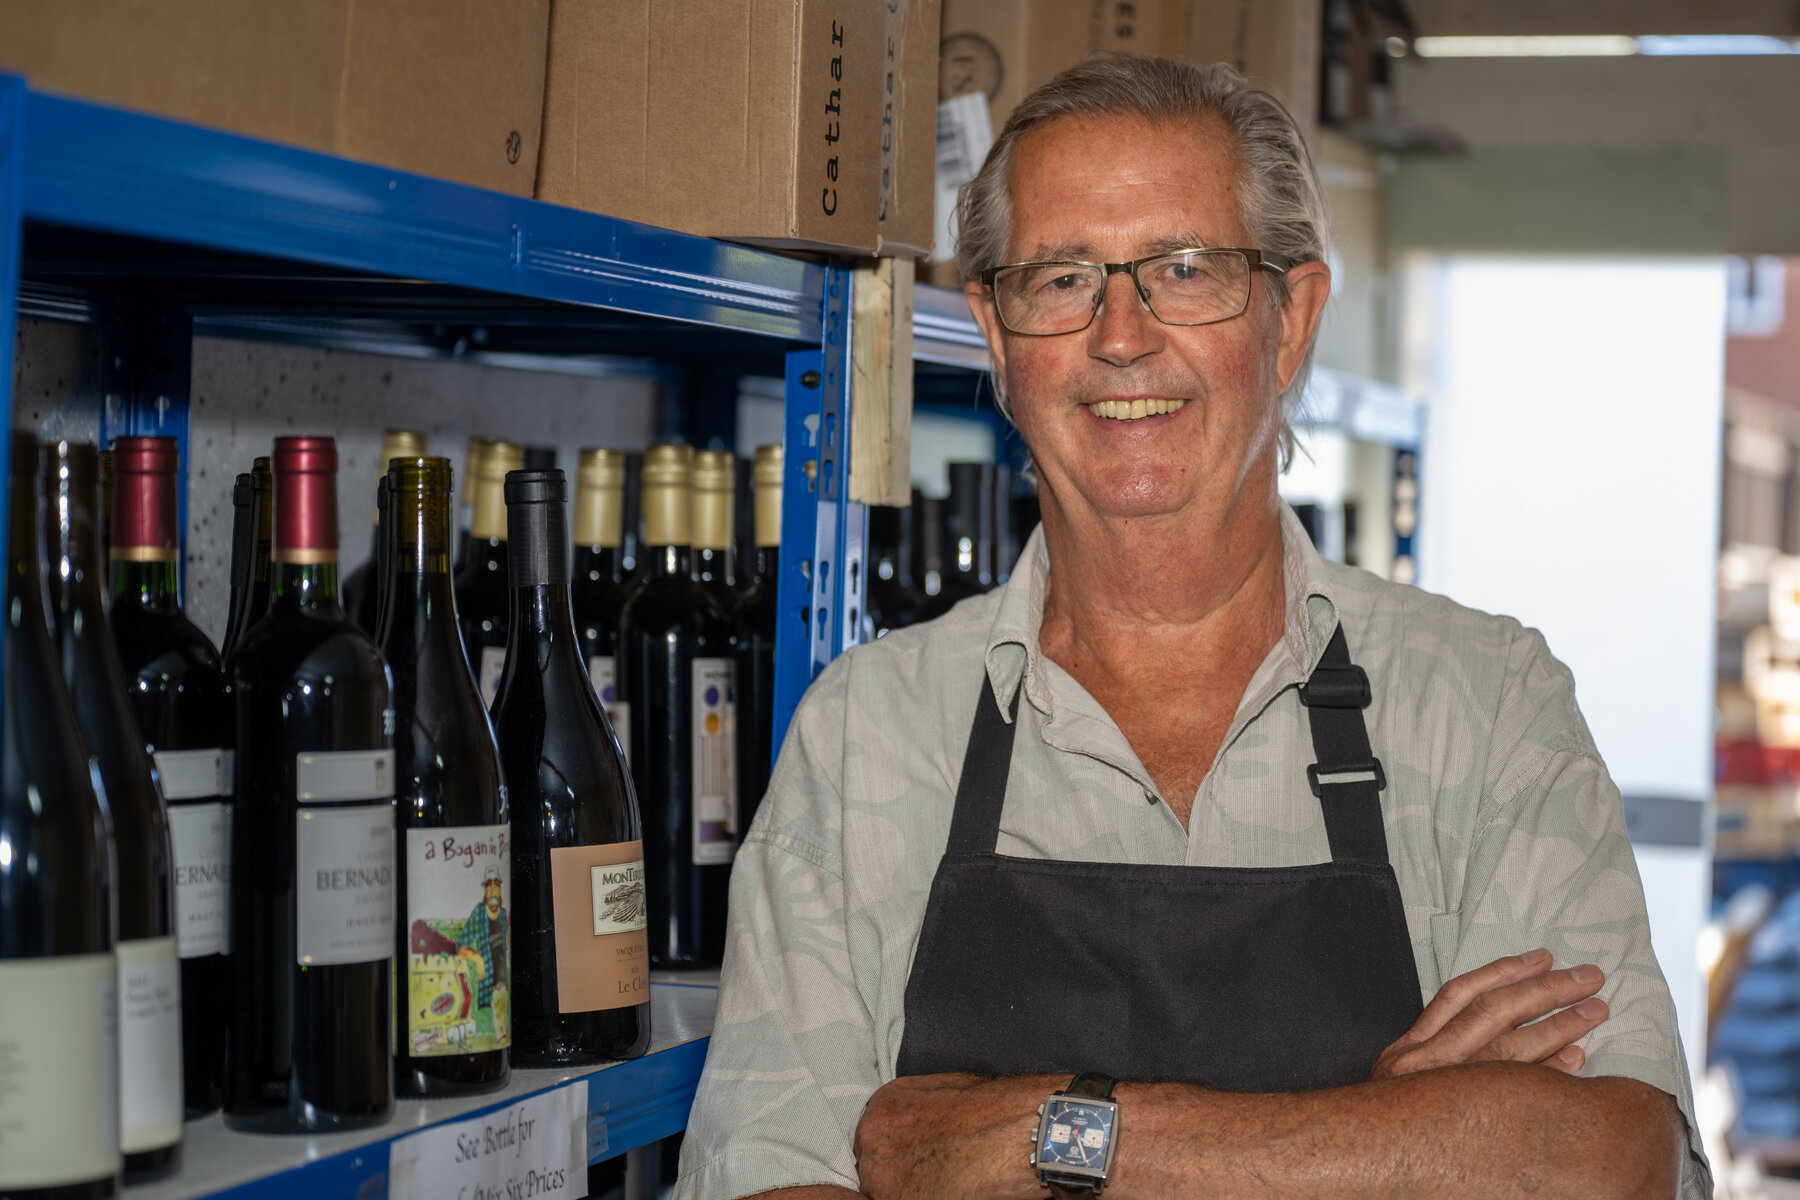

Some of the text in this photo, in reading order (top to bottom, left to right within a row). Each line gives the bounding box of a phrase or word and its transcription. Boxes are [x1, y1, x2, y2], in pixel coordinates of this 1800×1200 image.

[822, 19, 844, 217] Cathar
[878, 36, 895, 222] Cathar
[424, 841, 436, 860] a
[442, 836, 487, 868] Bogan
[489, 837, 497, 856] in
[316, 865, 393, 891] BERNAD
[618, 980, 630, 994] Le
[455, 1106, 535, 1163] See Bottle for
[525, 1166, 565, 1198] Prices
